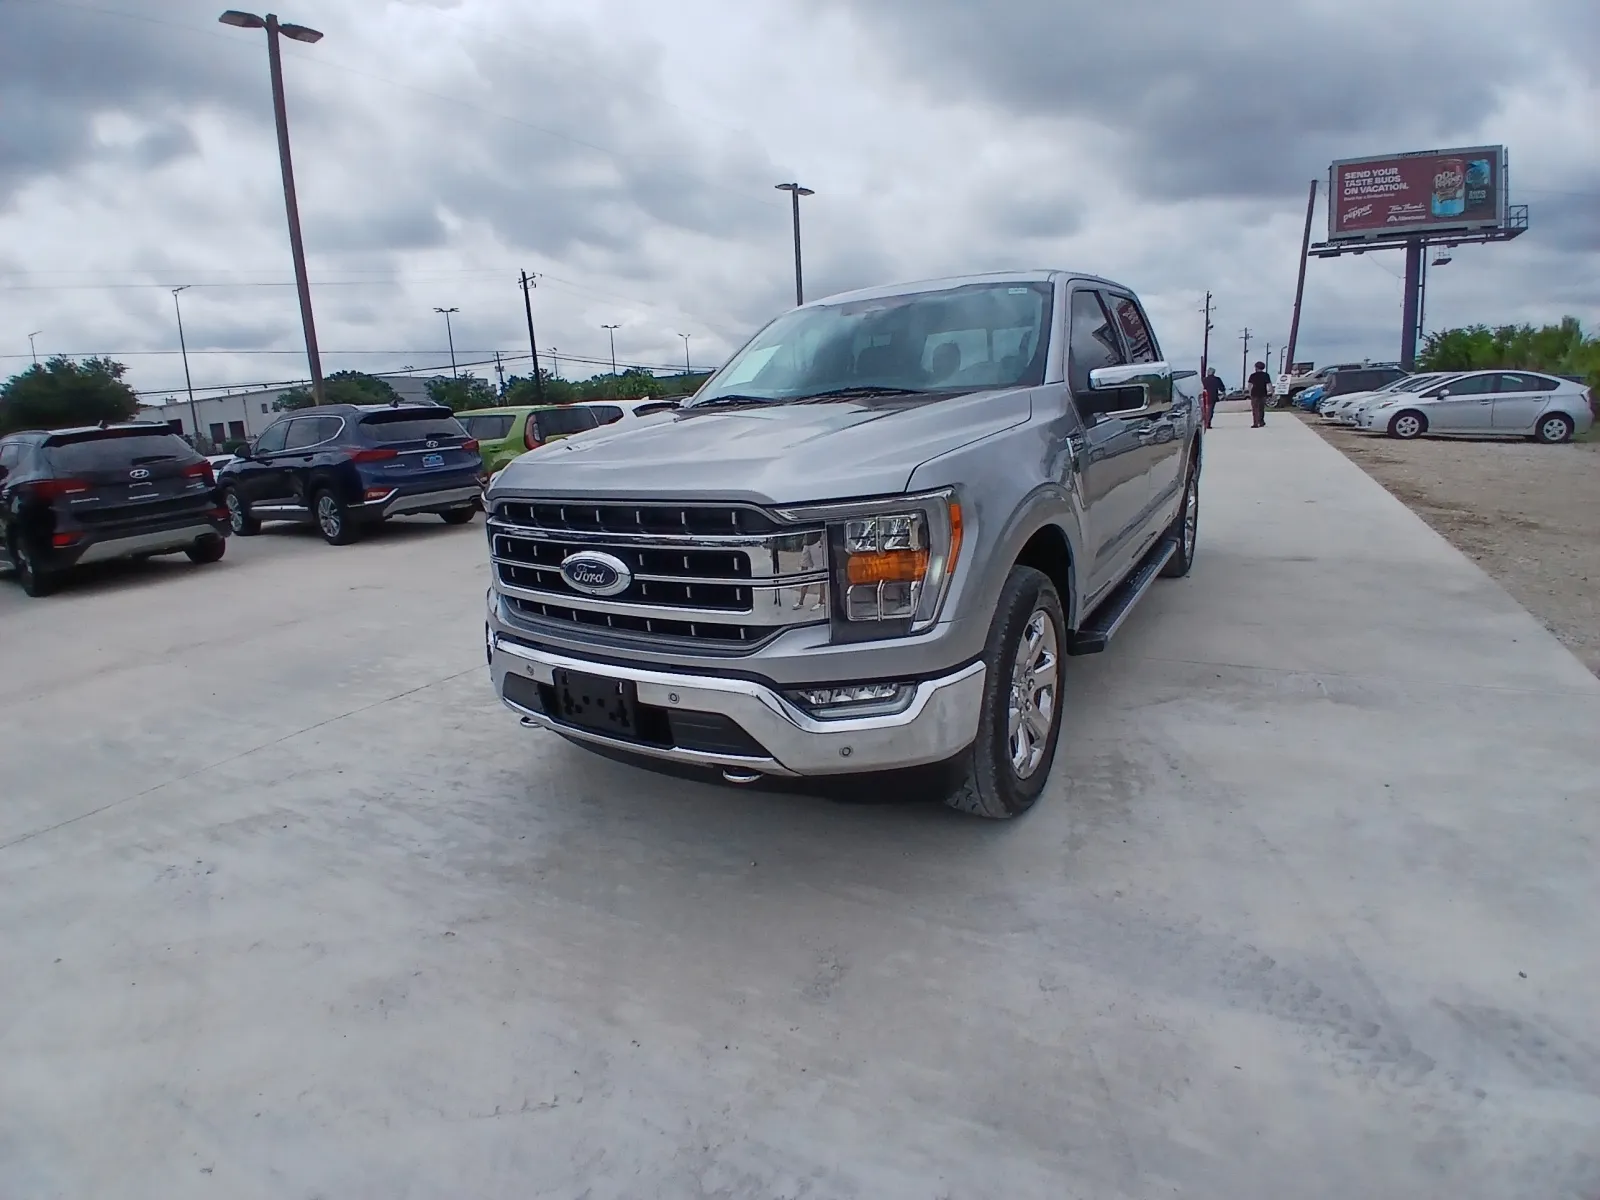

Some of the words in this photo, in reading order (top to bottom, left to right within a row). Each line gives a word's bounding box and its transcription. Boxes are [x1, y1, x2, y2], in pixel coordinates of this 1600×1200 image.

[1344, 170, 1371, 180] SEND
[1372, 167, 1399, 177] YOUR
[1344, 177, 1373, 187] TASTE
[1374, 175, 1401, 184] BUDS
[1344, 186, 1358, 195] ON
[1360, 182, 1409, 193] VACATION.
[1343, 204, 1372, 223] pepper
[573, 563, 606, 583] Ford
